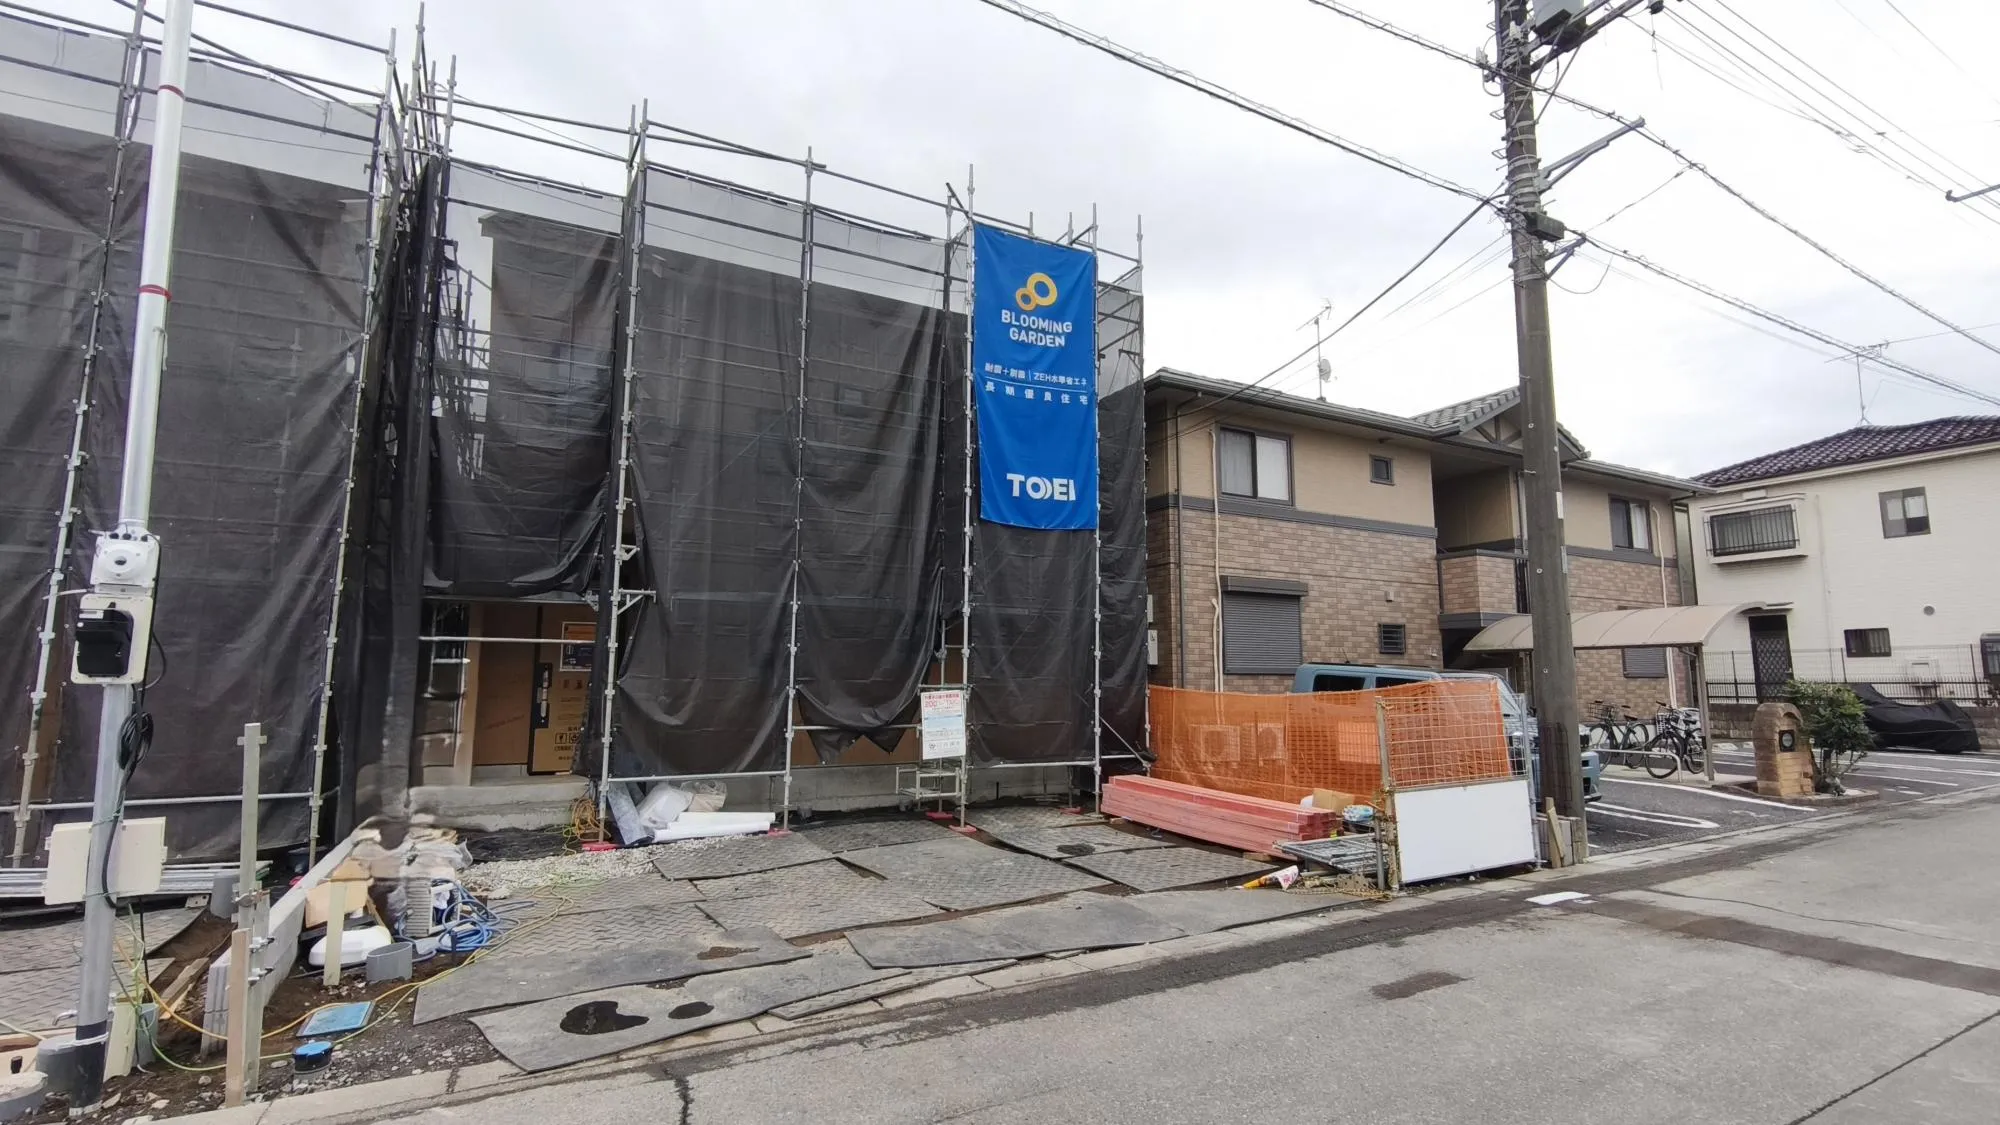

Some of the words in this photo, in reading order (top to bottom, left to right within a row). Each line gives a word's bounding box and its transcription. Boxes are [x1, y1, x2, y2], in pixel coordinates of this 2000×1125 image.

[1001, 309, 1073, 334] BLOOMING
[1009, 327, 1066, 348] GARDEN
[1006, 473, 1076, 501] TOEI
